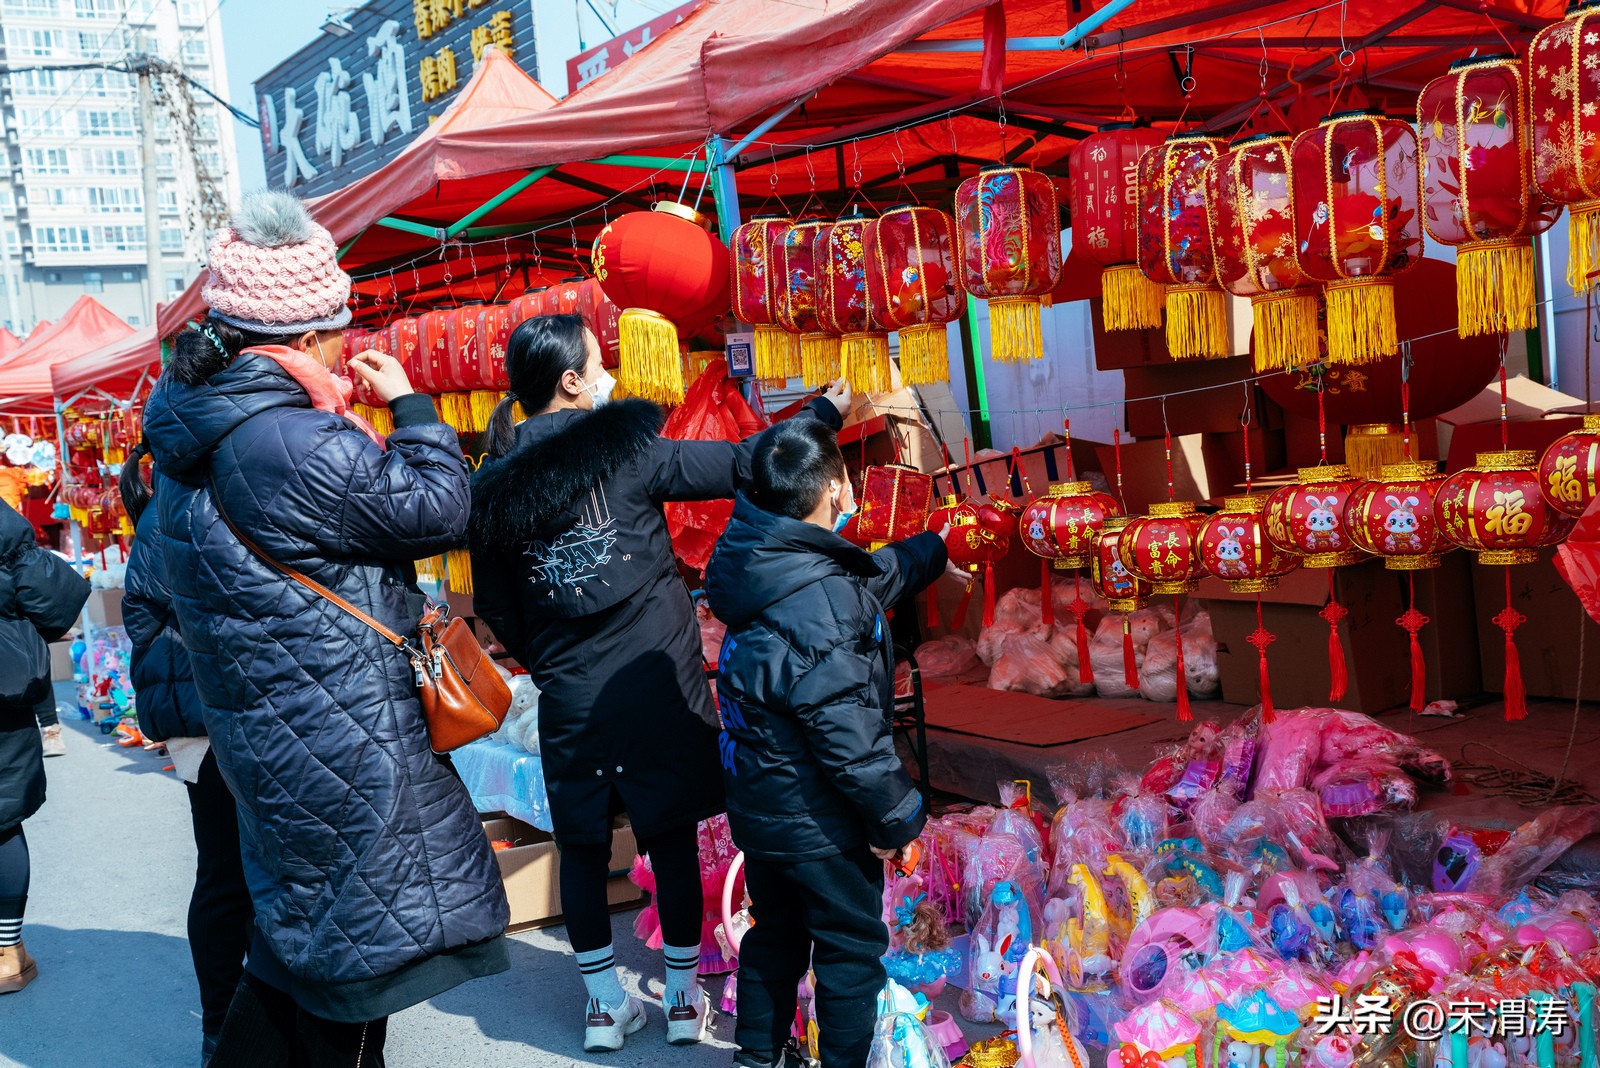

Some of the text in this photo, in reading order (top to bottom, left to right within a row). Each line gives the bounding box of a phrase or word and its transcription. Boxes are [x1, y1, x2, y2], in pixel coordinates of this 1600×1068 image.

[1088, 226, 1109, 249] 福
[490, 343, 505, 358] 福
[1549, 454, 1583, 503] 福
[1081, 508, 1096, 539] 長命
[1485, 489, 1532, 536] 福
[1066, 517, 1081, 549] 富貴
[1164, 531, 1182, 568] 長命
[1148, 541, 1164, 575] 富貴
[528, 554, 631, 599] PARIS
